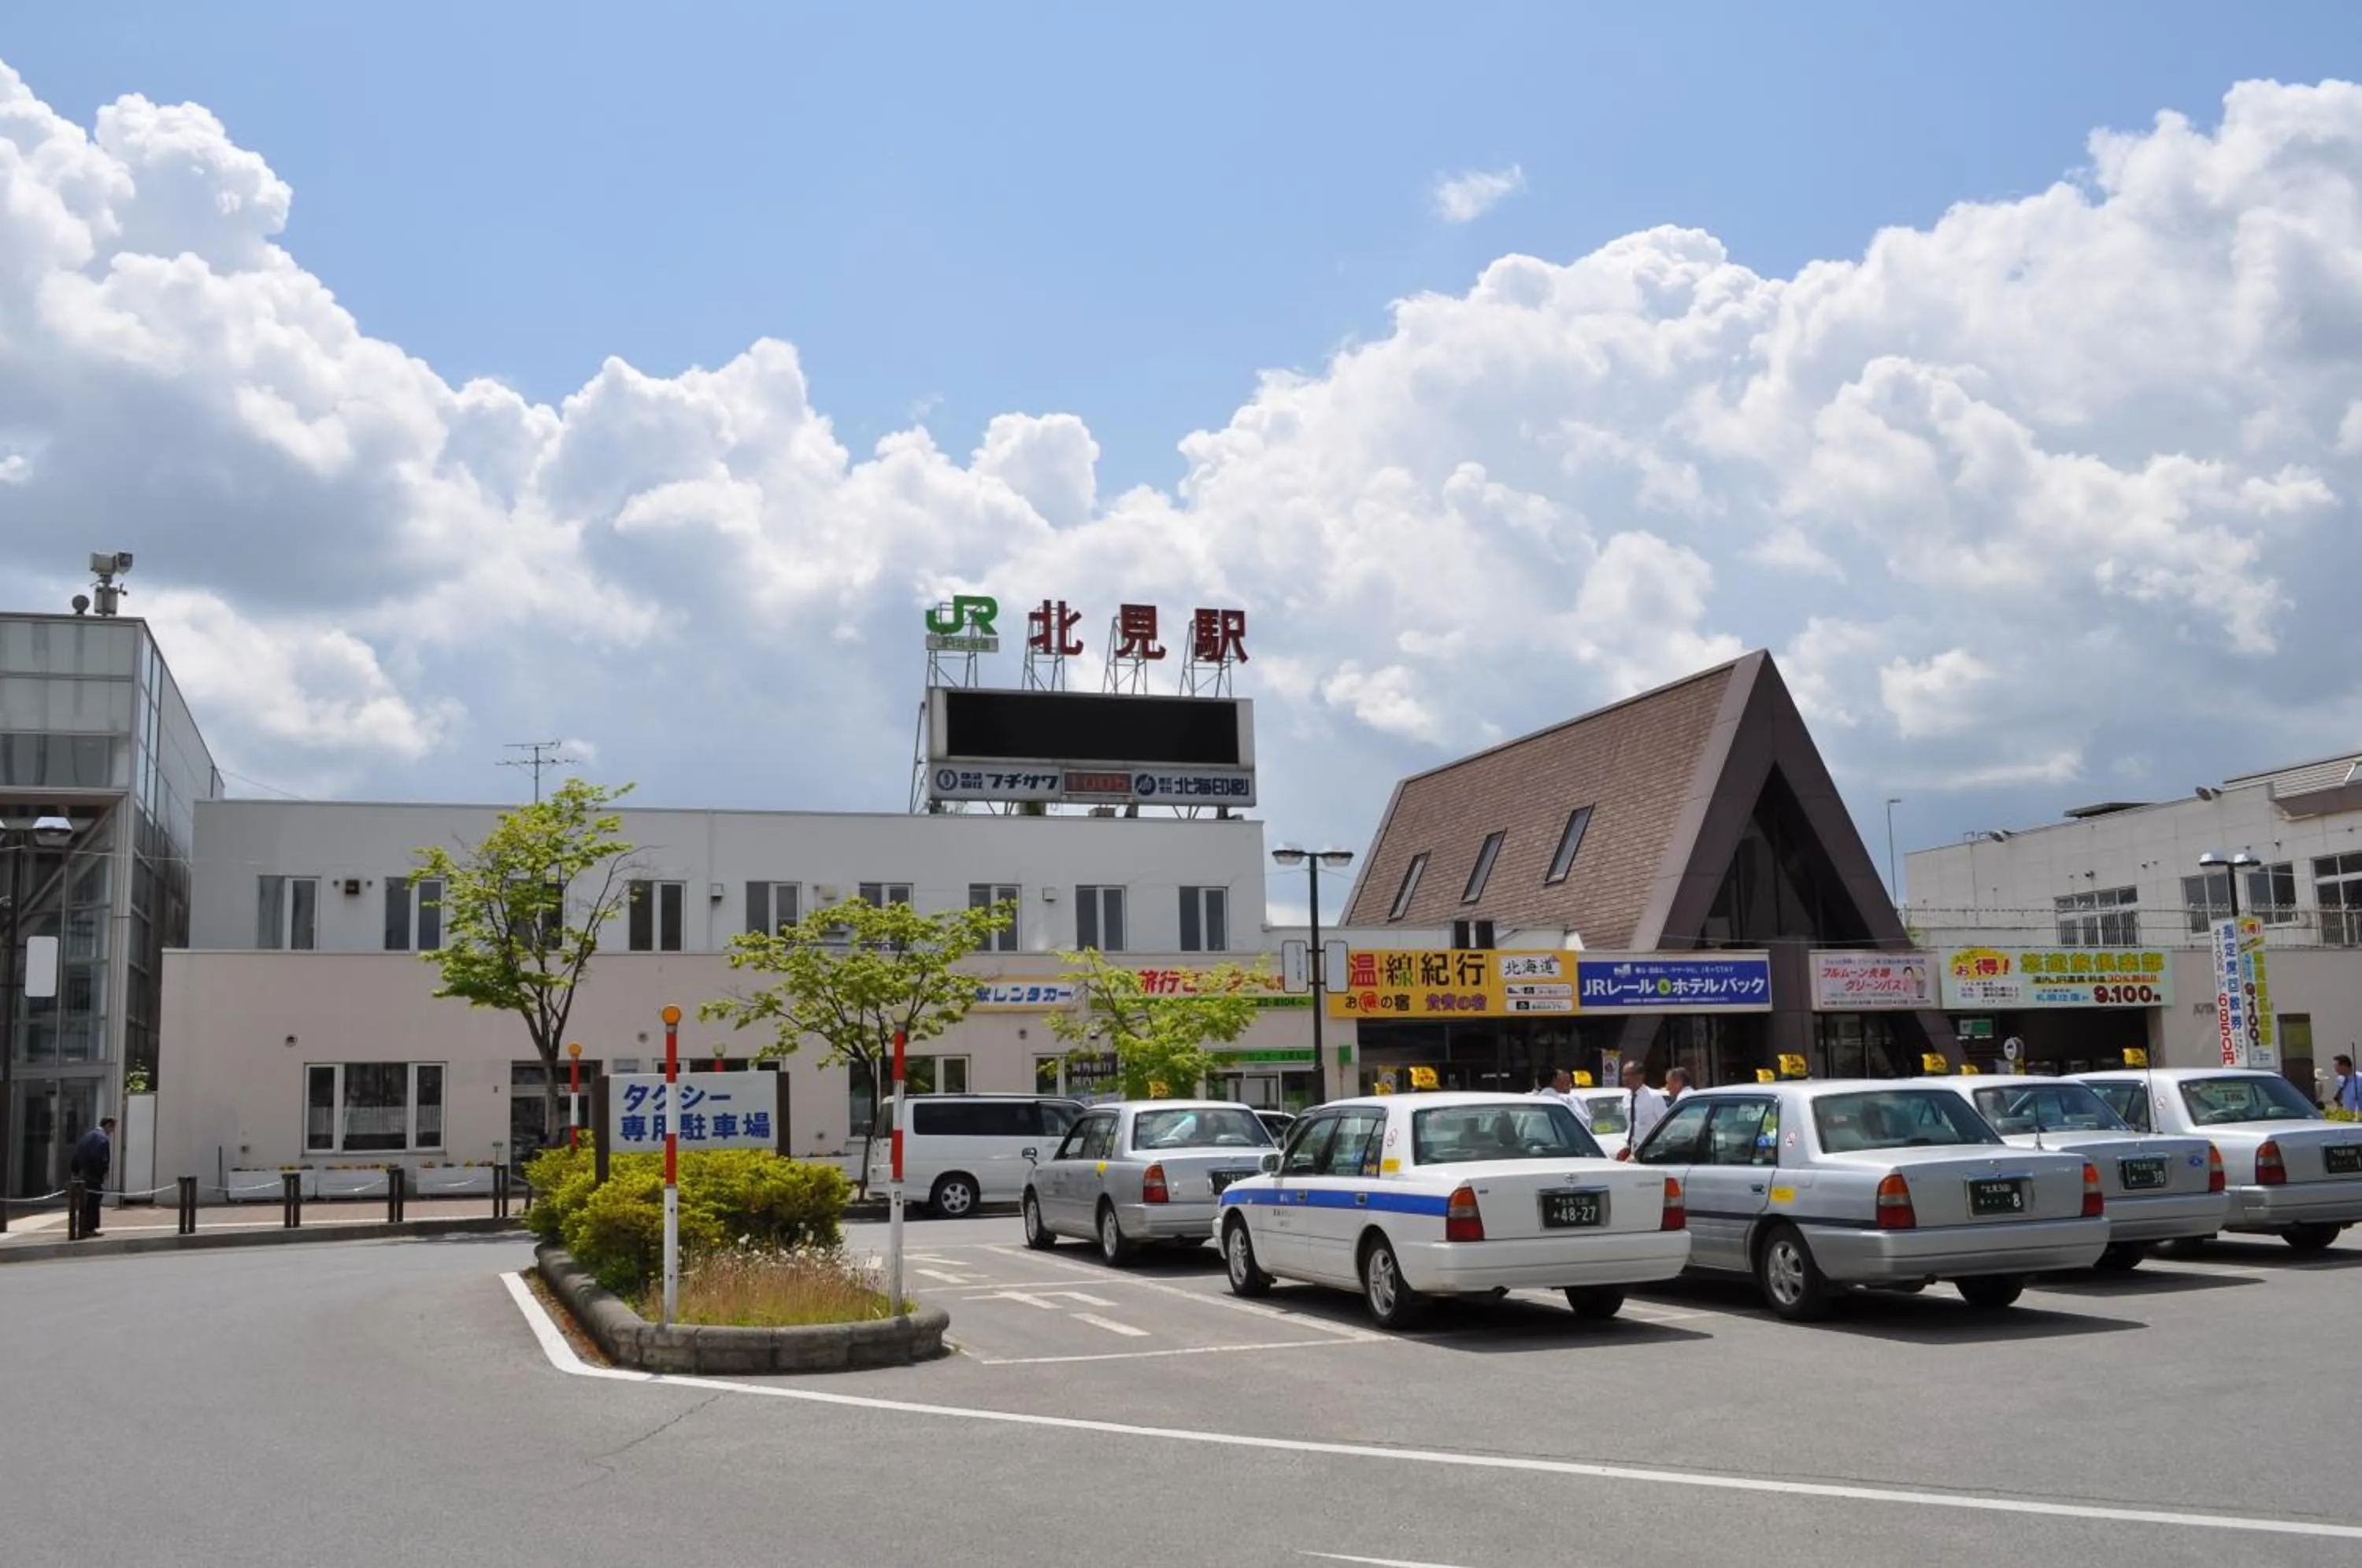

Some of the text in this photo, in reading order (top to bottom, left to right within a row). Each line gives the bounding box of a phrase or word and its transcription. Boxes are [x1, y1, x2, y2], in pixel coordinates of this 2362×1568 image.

[926, 595, 998, 634] JR
[1028, 600, 1248, 663] 北見駅
[624, 1084, 731, 1112] タクシー
[620, 1112, 771, 1142] 専用駐車場
[1560, 1206, 1597, 1222] 48-27
